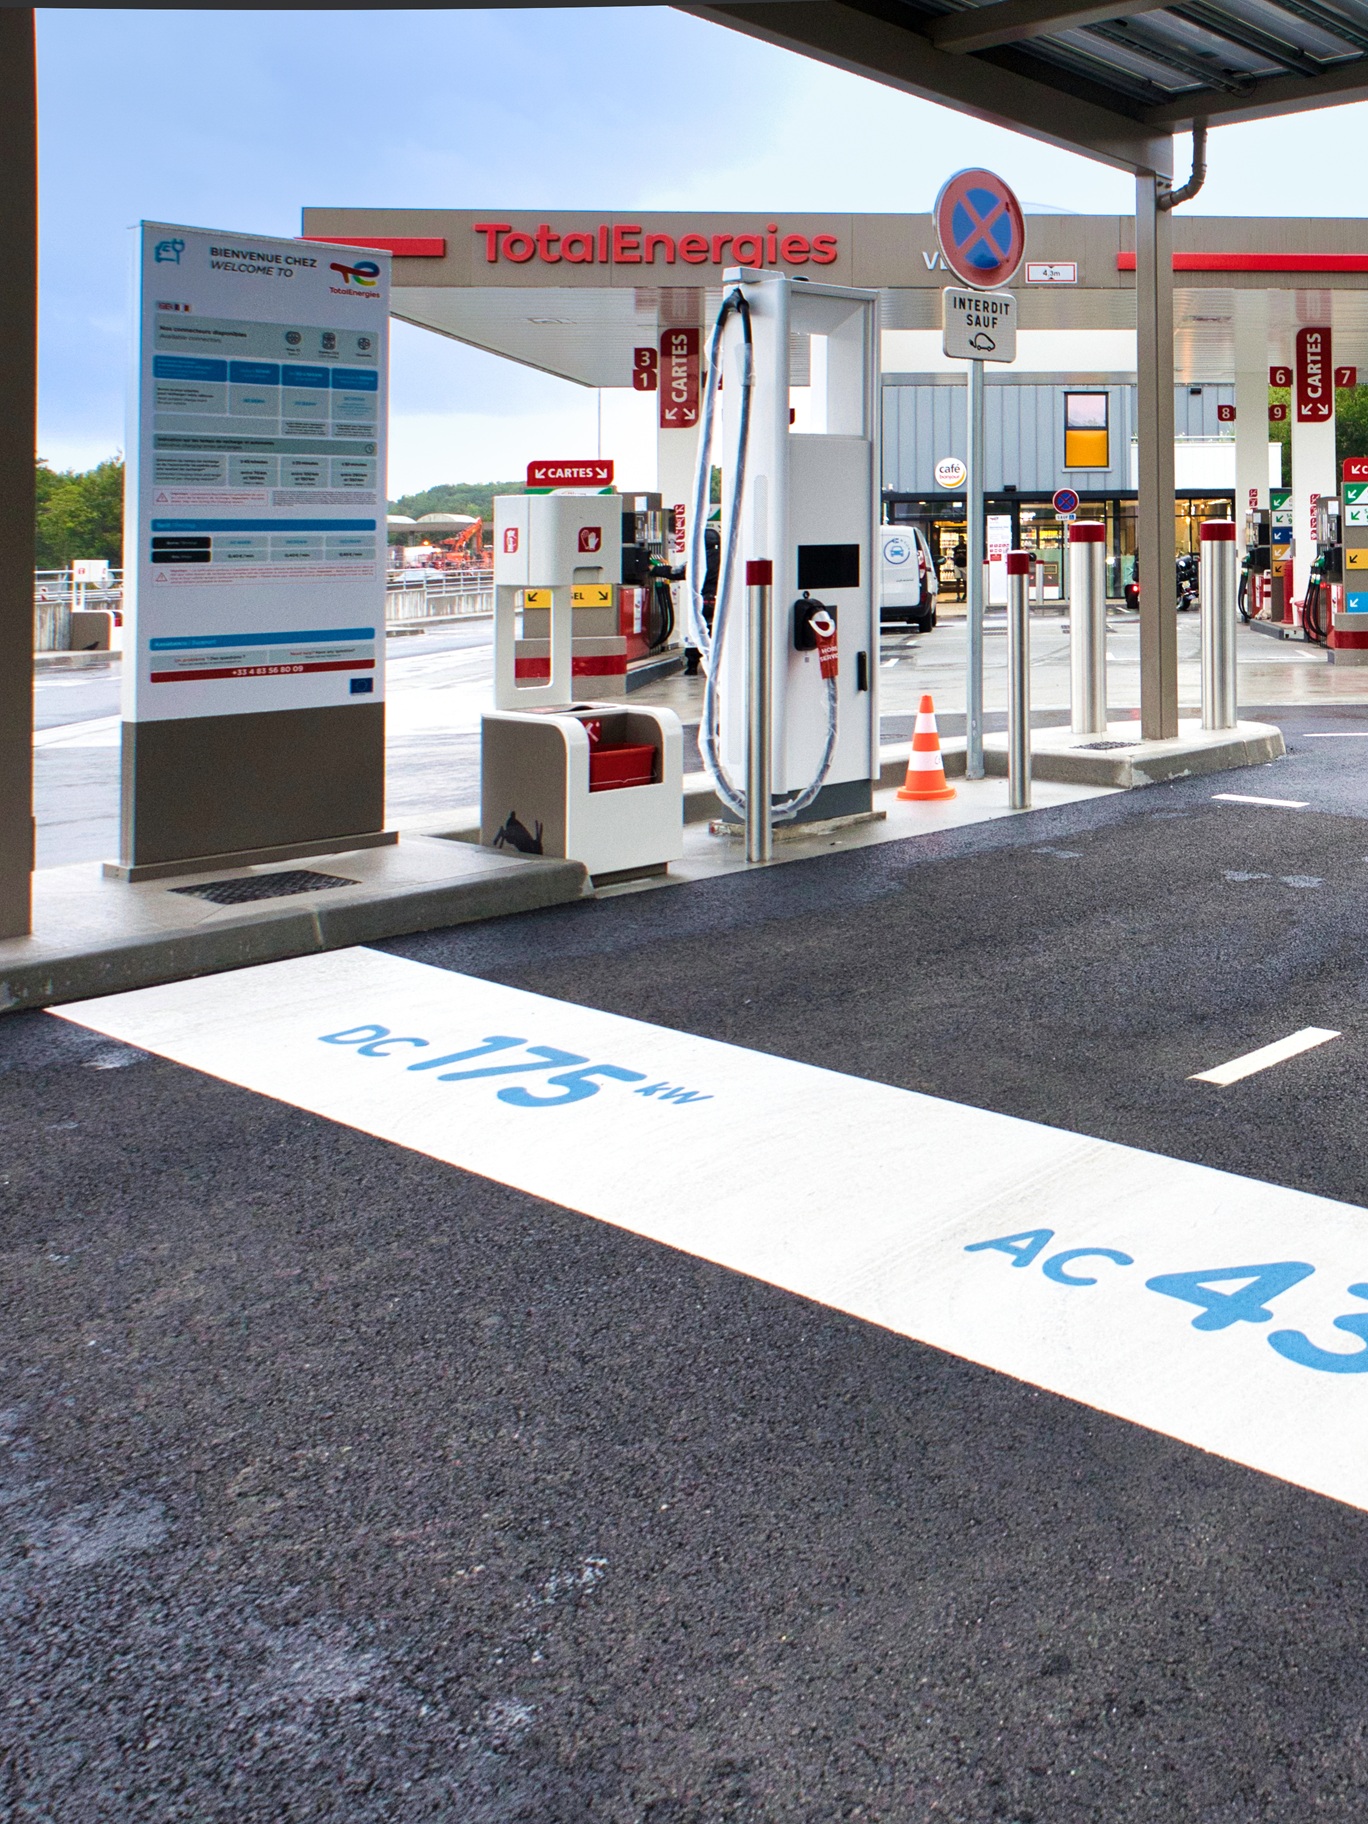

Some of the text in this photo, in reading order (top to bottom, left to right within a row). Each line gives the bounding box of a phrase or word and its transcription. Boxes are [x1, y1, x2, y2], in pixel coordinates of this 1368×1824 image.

[473, 223, 838, 269] TotalEnergies
[210, 247, 317, 269] BIENVENUE CHEZ
[211, 260, 294, 278] WELCOME TO
[329, 286, 381, 300] TotalEnergies
[953, 297, 1010, 316] INTERDIT
[966, 313, 998, 329] SAUF
[640, 351, 651, 367] 3
[1306, 332, 1323, 399] CARTES
[671, 334, 688, 403] CARTES
[639, 372, 649, 388] 1
[1275, 369, 1286, 385] 6
[1340, 369, 1351, 385] 7
[1221, 407, 1231, 419] 8
[1273, 407, 1282, 419] 9
[547, 467, 593, 479] CARTES
[939, 463, 961, 474] café
[231, 664, 304, 677] +33 4 83 56 80 09
[318, 1024, 715, 1108] DC 175 kW
[964, 1228, 1134, 1286] AC
